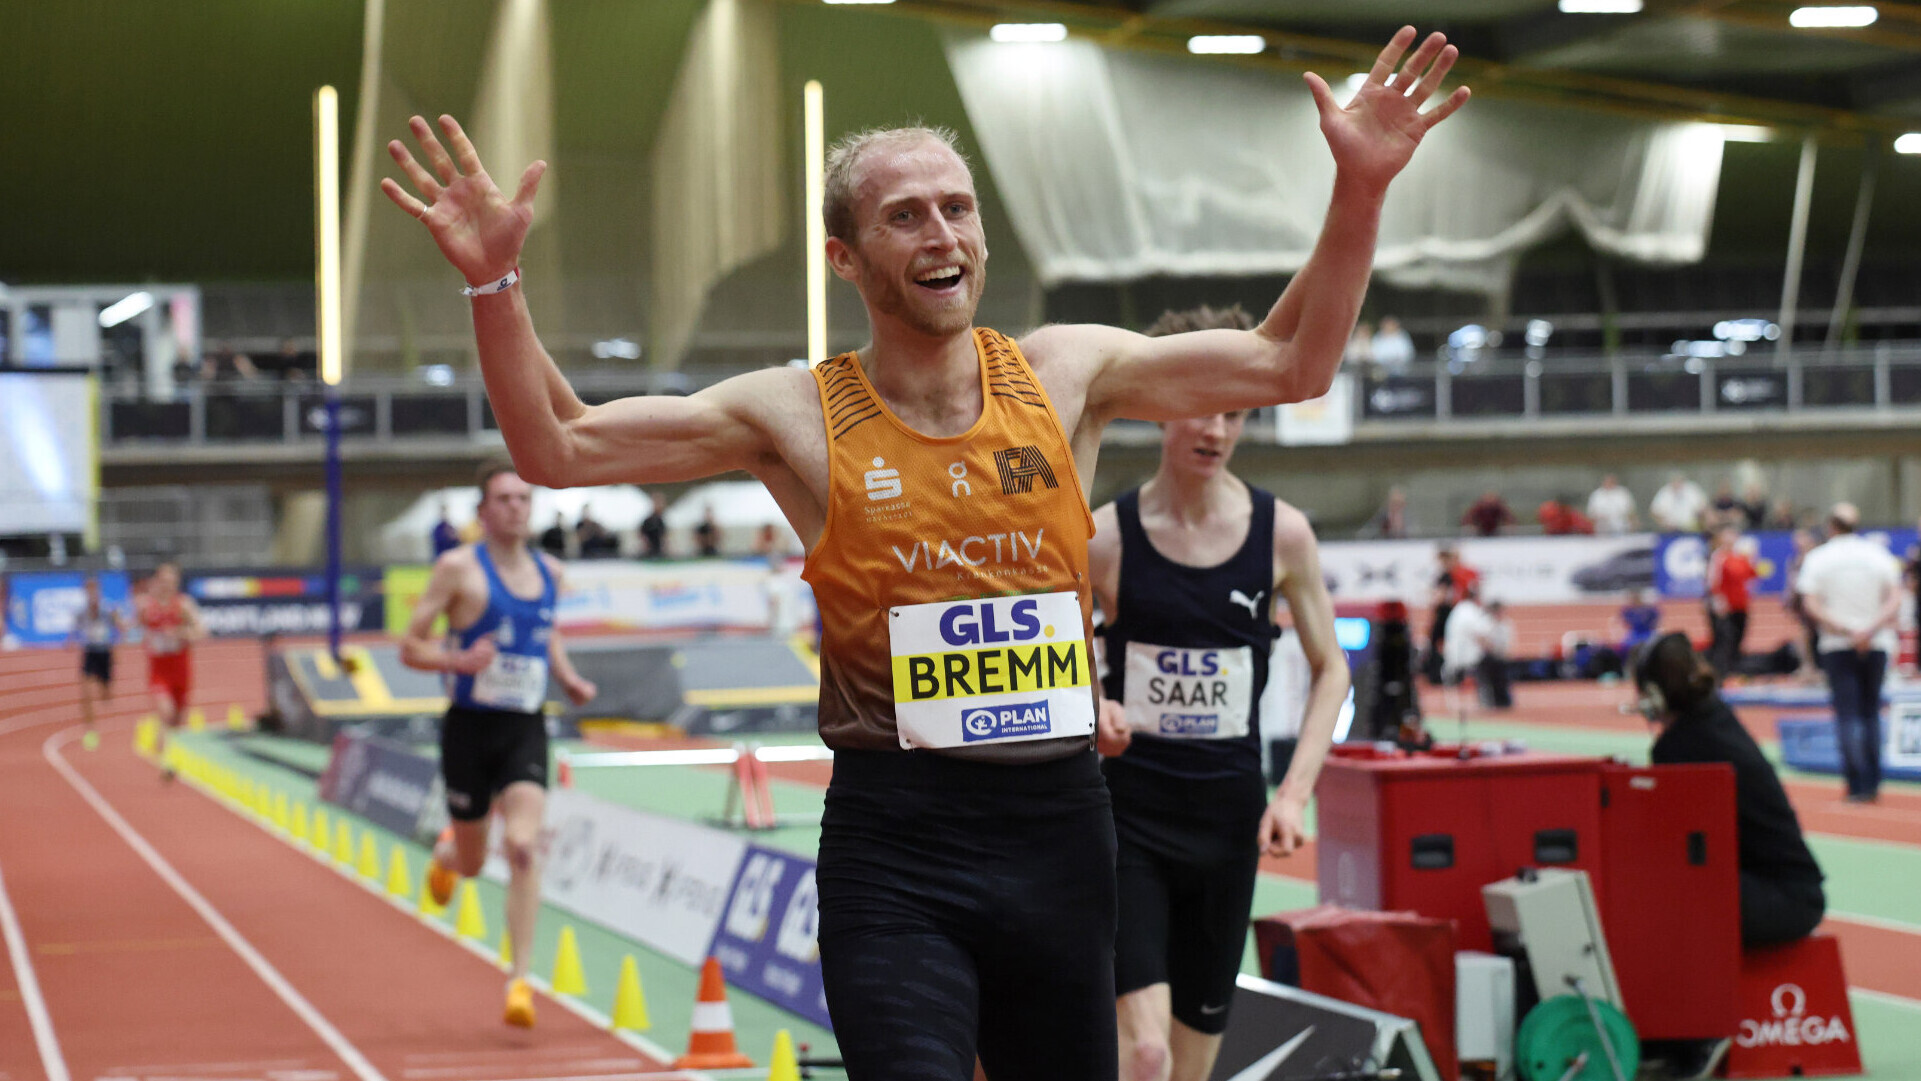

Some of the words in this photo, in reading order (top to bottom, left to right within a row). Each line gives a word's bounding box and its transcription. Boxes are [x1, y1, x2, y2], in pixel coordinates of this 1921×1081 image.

[892, 528, 1044, 573] VIACTIV
[909, 643, 1079, 700] BREMM
[1148, 677, 1228, 706] SAAR
[1000, 707, 1047, 726] PLAN
[1001, 724, 1048, 734] INTERNATIONAL
[1736, 1014, 1850, 1048] OMEGA
